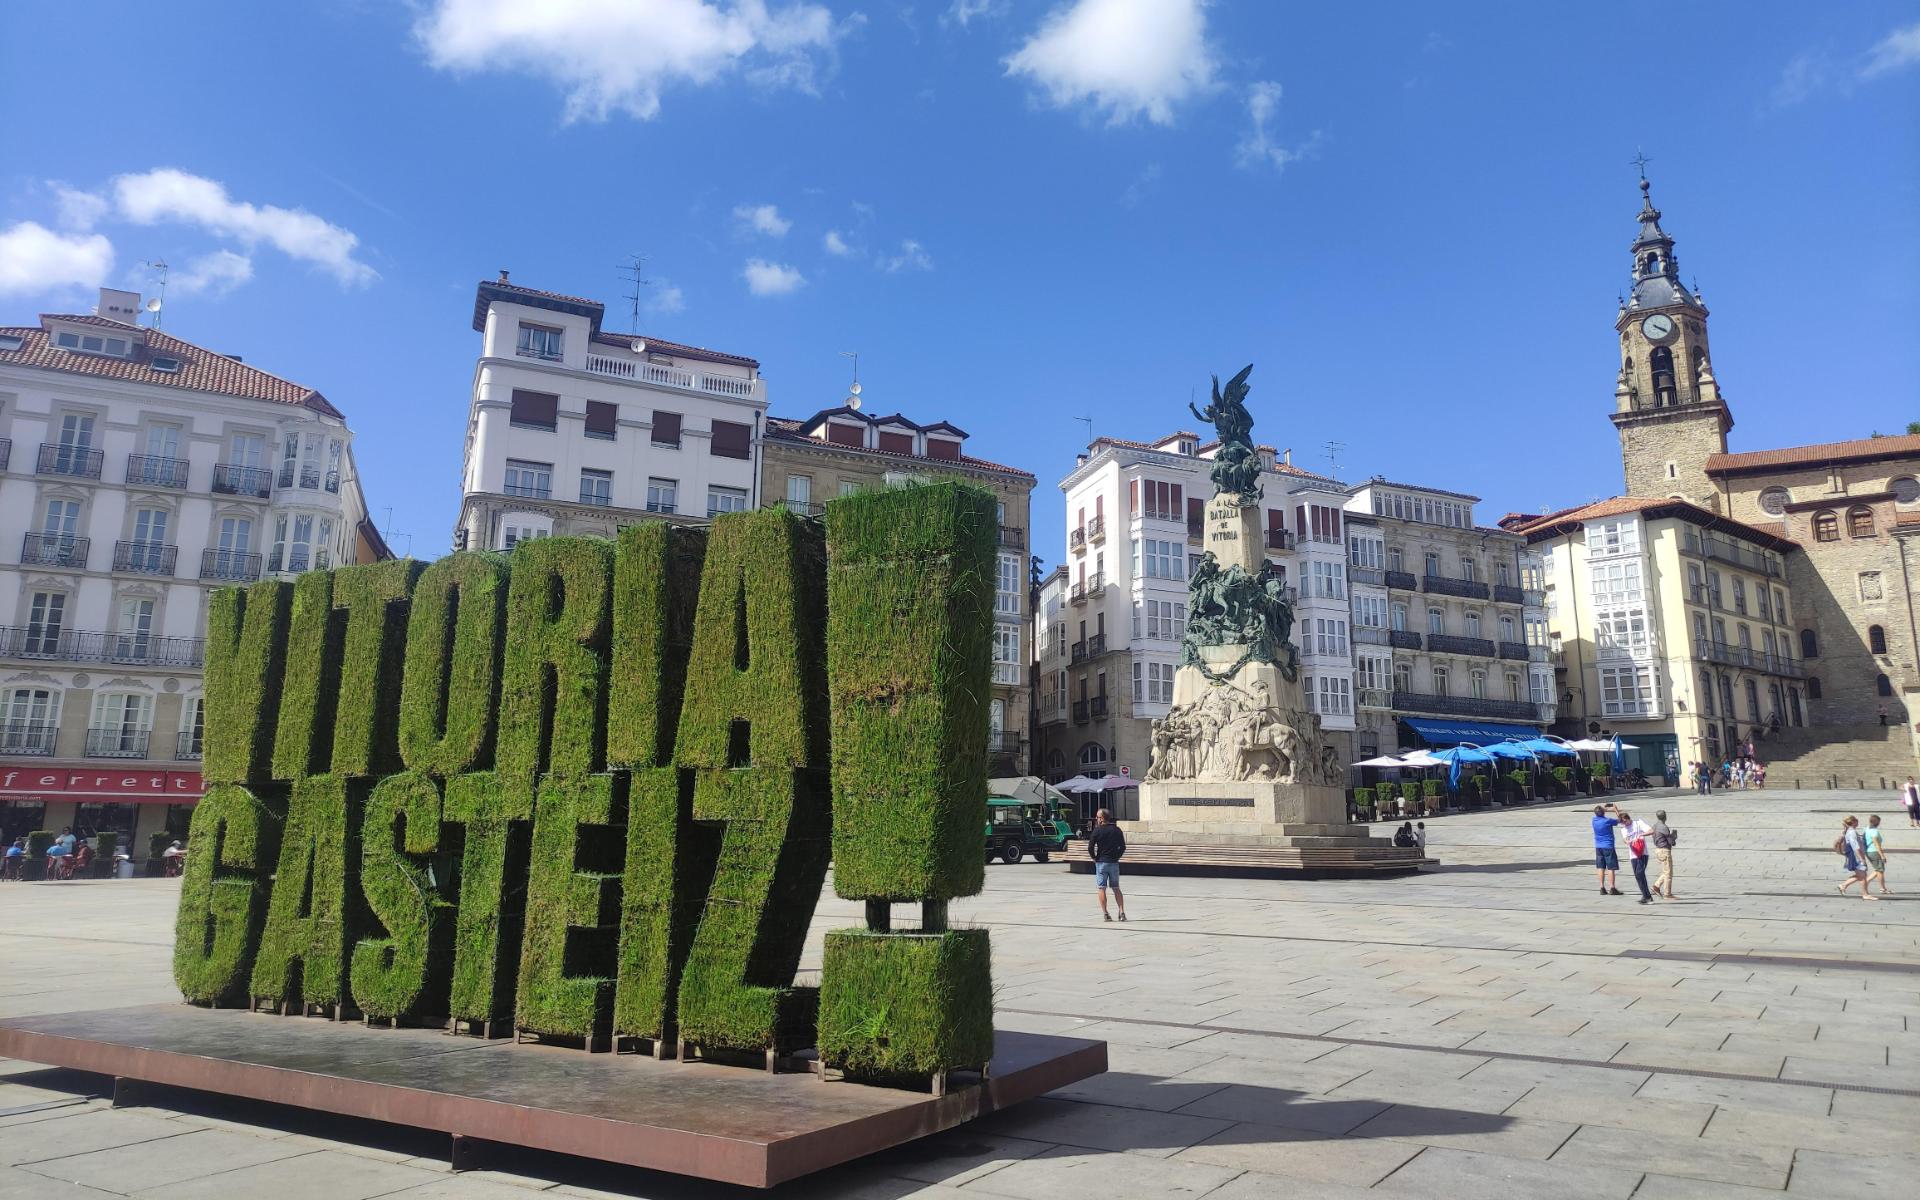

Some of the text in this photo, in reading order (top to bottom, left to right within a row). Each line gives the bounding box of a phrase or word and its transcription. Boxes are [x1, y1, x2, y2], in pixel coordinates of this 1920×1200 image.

[1210, 508, 1239, 521] BATALLA
[1220, 521, 1228, 529] DE
[1211, 530, 1239, 542] VITORIA
[204, 506, 810, 783] VITORIA
